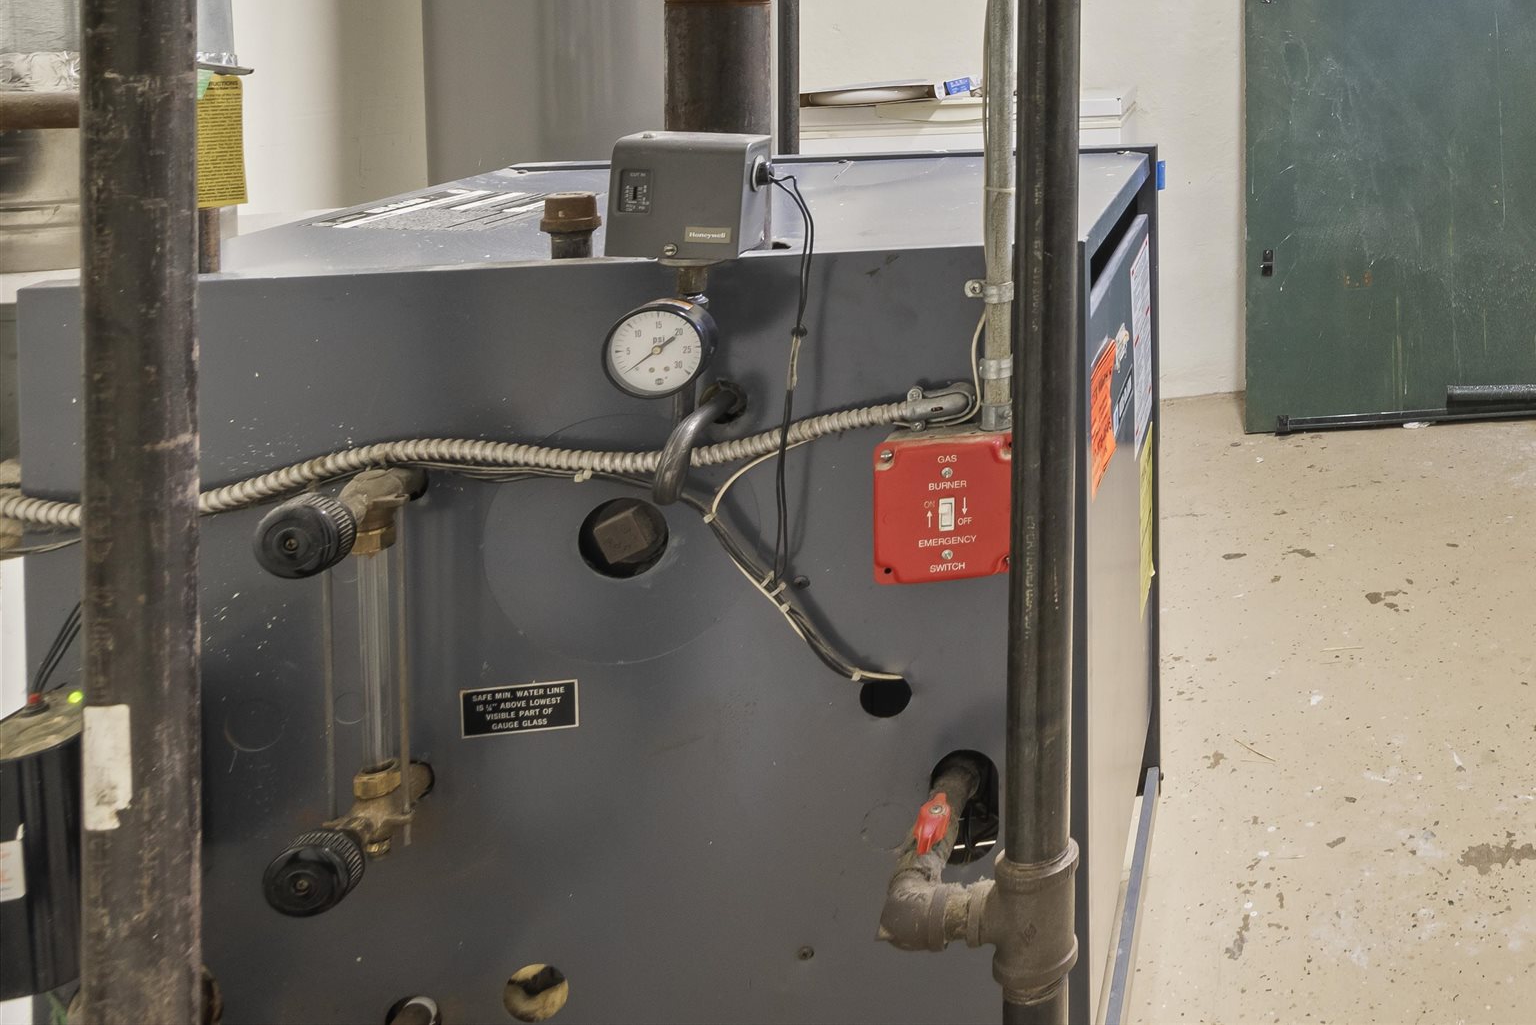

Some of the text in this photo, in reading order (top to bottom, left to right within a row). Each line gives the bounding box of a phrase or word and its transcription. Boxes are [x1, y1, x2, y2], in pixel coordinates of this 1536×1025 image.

[635, 330, 642, 338] 10
[675, 327, 684, 336] 20
[652, 336, 665, 345] psi
[683, 346, 692, 354] 25
[674, 361, 683, 369] 30
[937, 454, 957, 463] GAS
[928, 480, 967, 491] BURNER
[957, 517, 973, 526] OFF
[918, 534, 977, 548] EMERGENCY
[929, 562, 966, 573] SWITCH
[472, 686, 565, 702] SAFE MIN. WATER LINE
[476, 704, 484, 712] IS
[500, 700, 527, 710] ABOVE
[530, 696, 562, 707] LOWEST
[485, 707, 554, 721] VISIBLE PART OF
[491, 718, 548, 730] GAUGE GLASS
